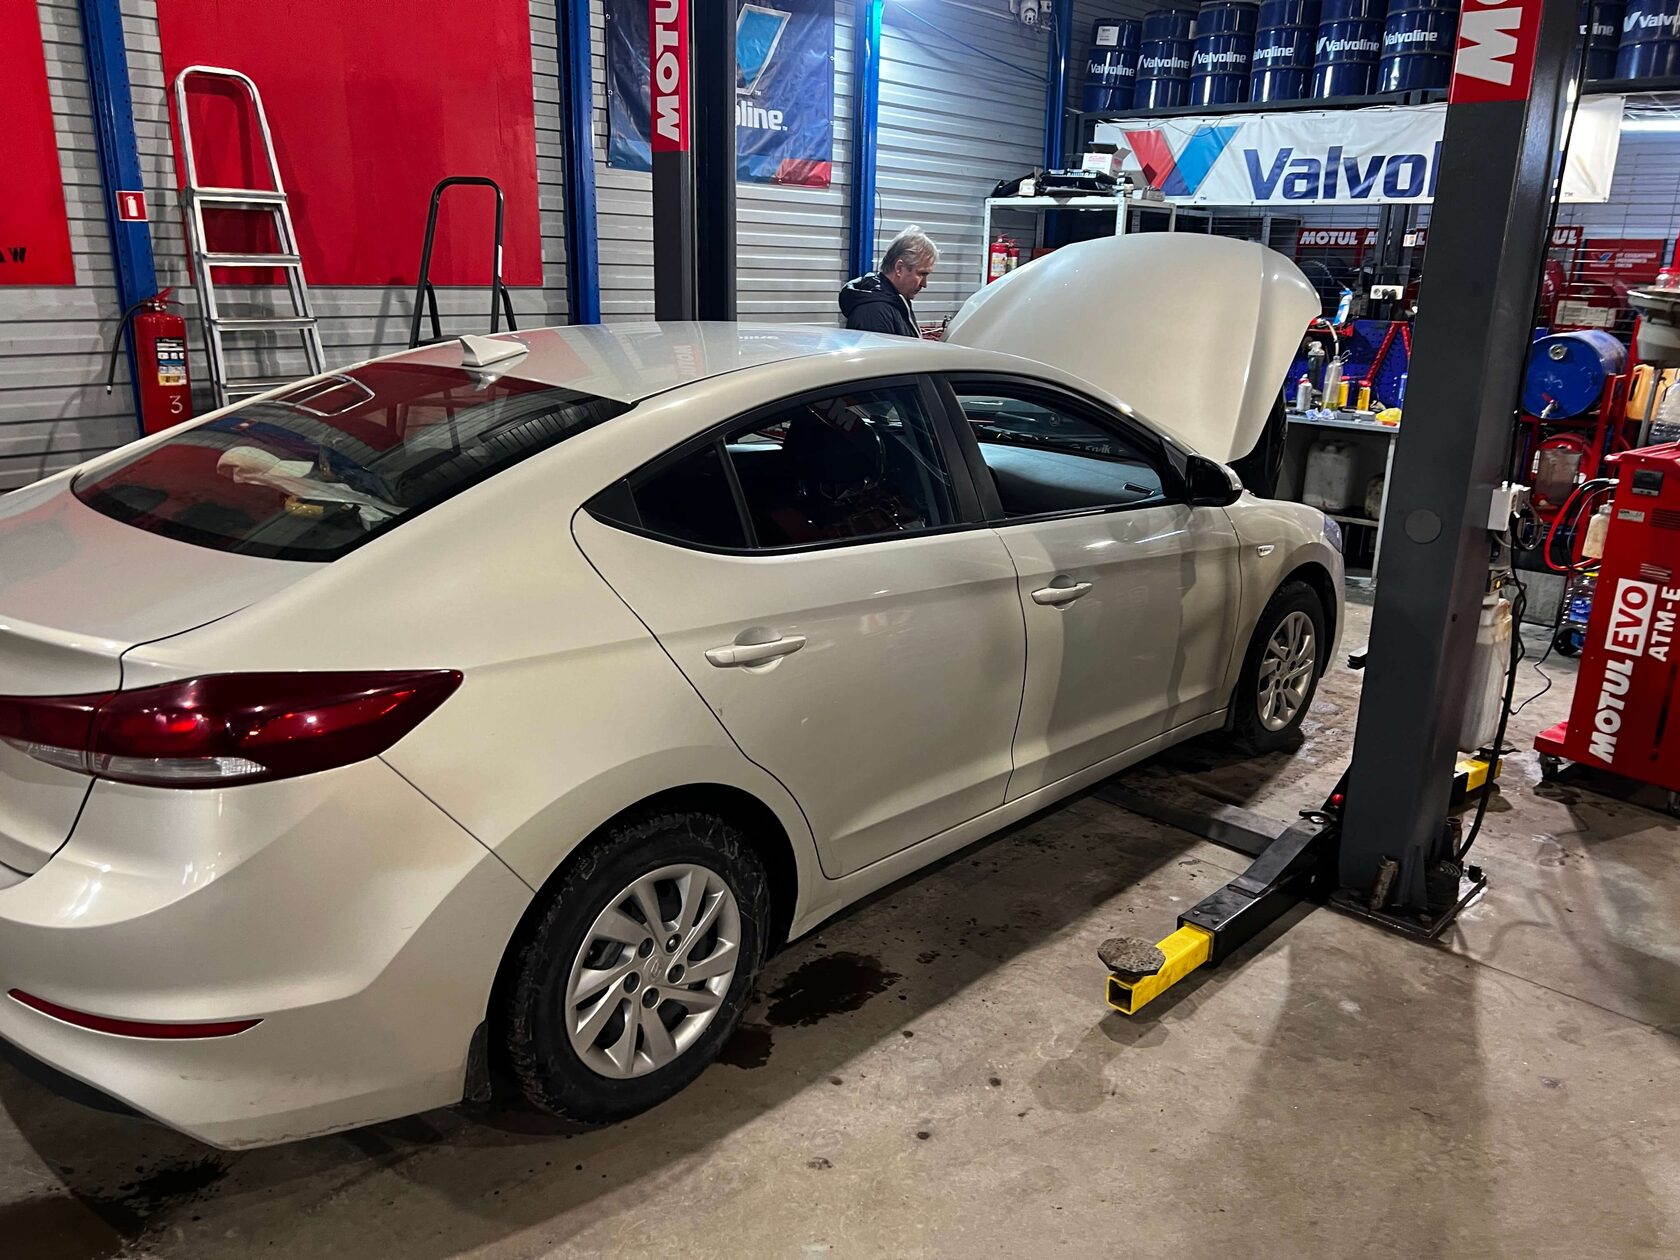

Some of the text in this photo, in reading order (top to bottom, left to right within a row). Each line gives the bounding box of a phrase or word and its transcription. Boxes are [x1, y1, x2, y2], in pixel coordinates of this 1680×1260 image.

[1326, 38, 1379, 52] Valvoline
[1384, 29, 1437, 46] Valvoline
[1455, 0, 1523, 86] M
[1143, 56, 1190, 70] Valvoline
[1197, 51, 1247, 64] Valvoline
[655, 0, 679, 142] MOTU
[1090, 62, 1135, 77] Valvoline
[1299, 231, 1359, 246] MOTUL
[169, 395, 183, 414] 3
[1648, 586, 1680, 662] ATM-E
[1588, 585, 1649, 764] MOTUL EVO
